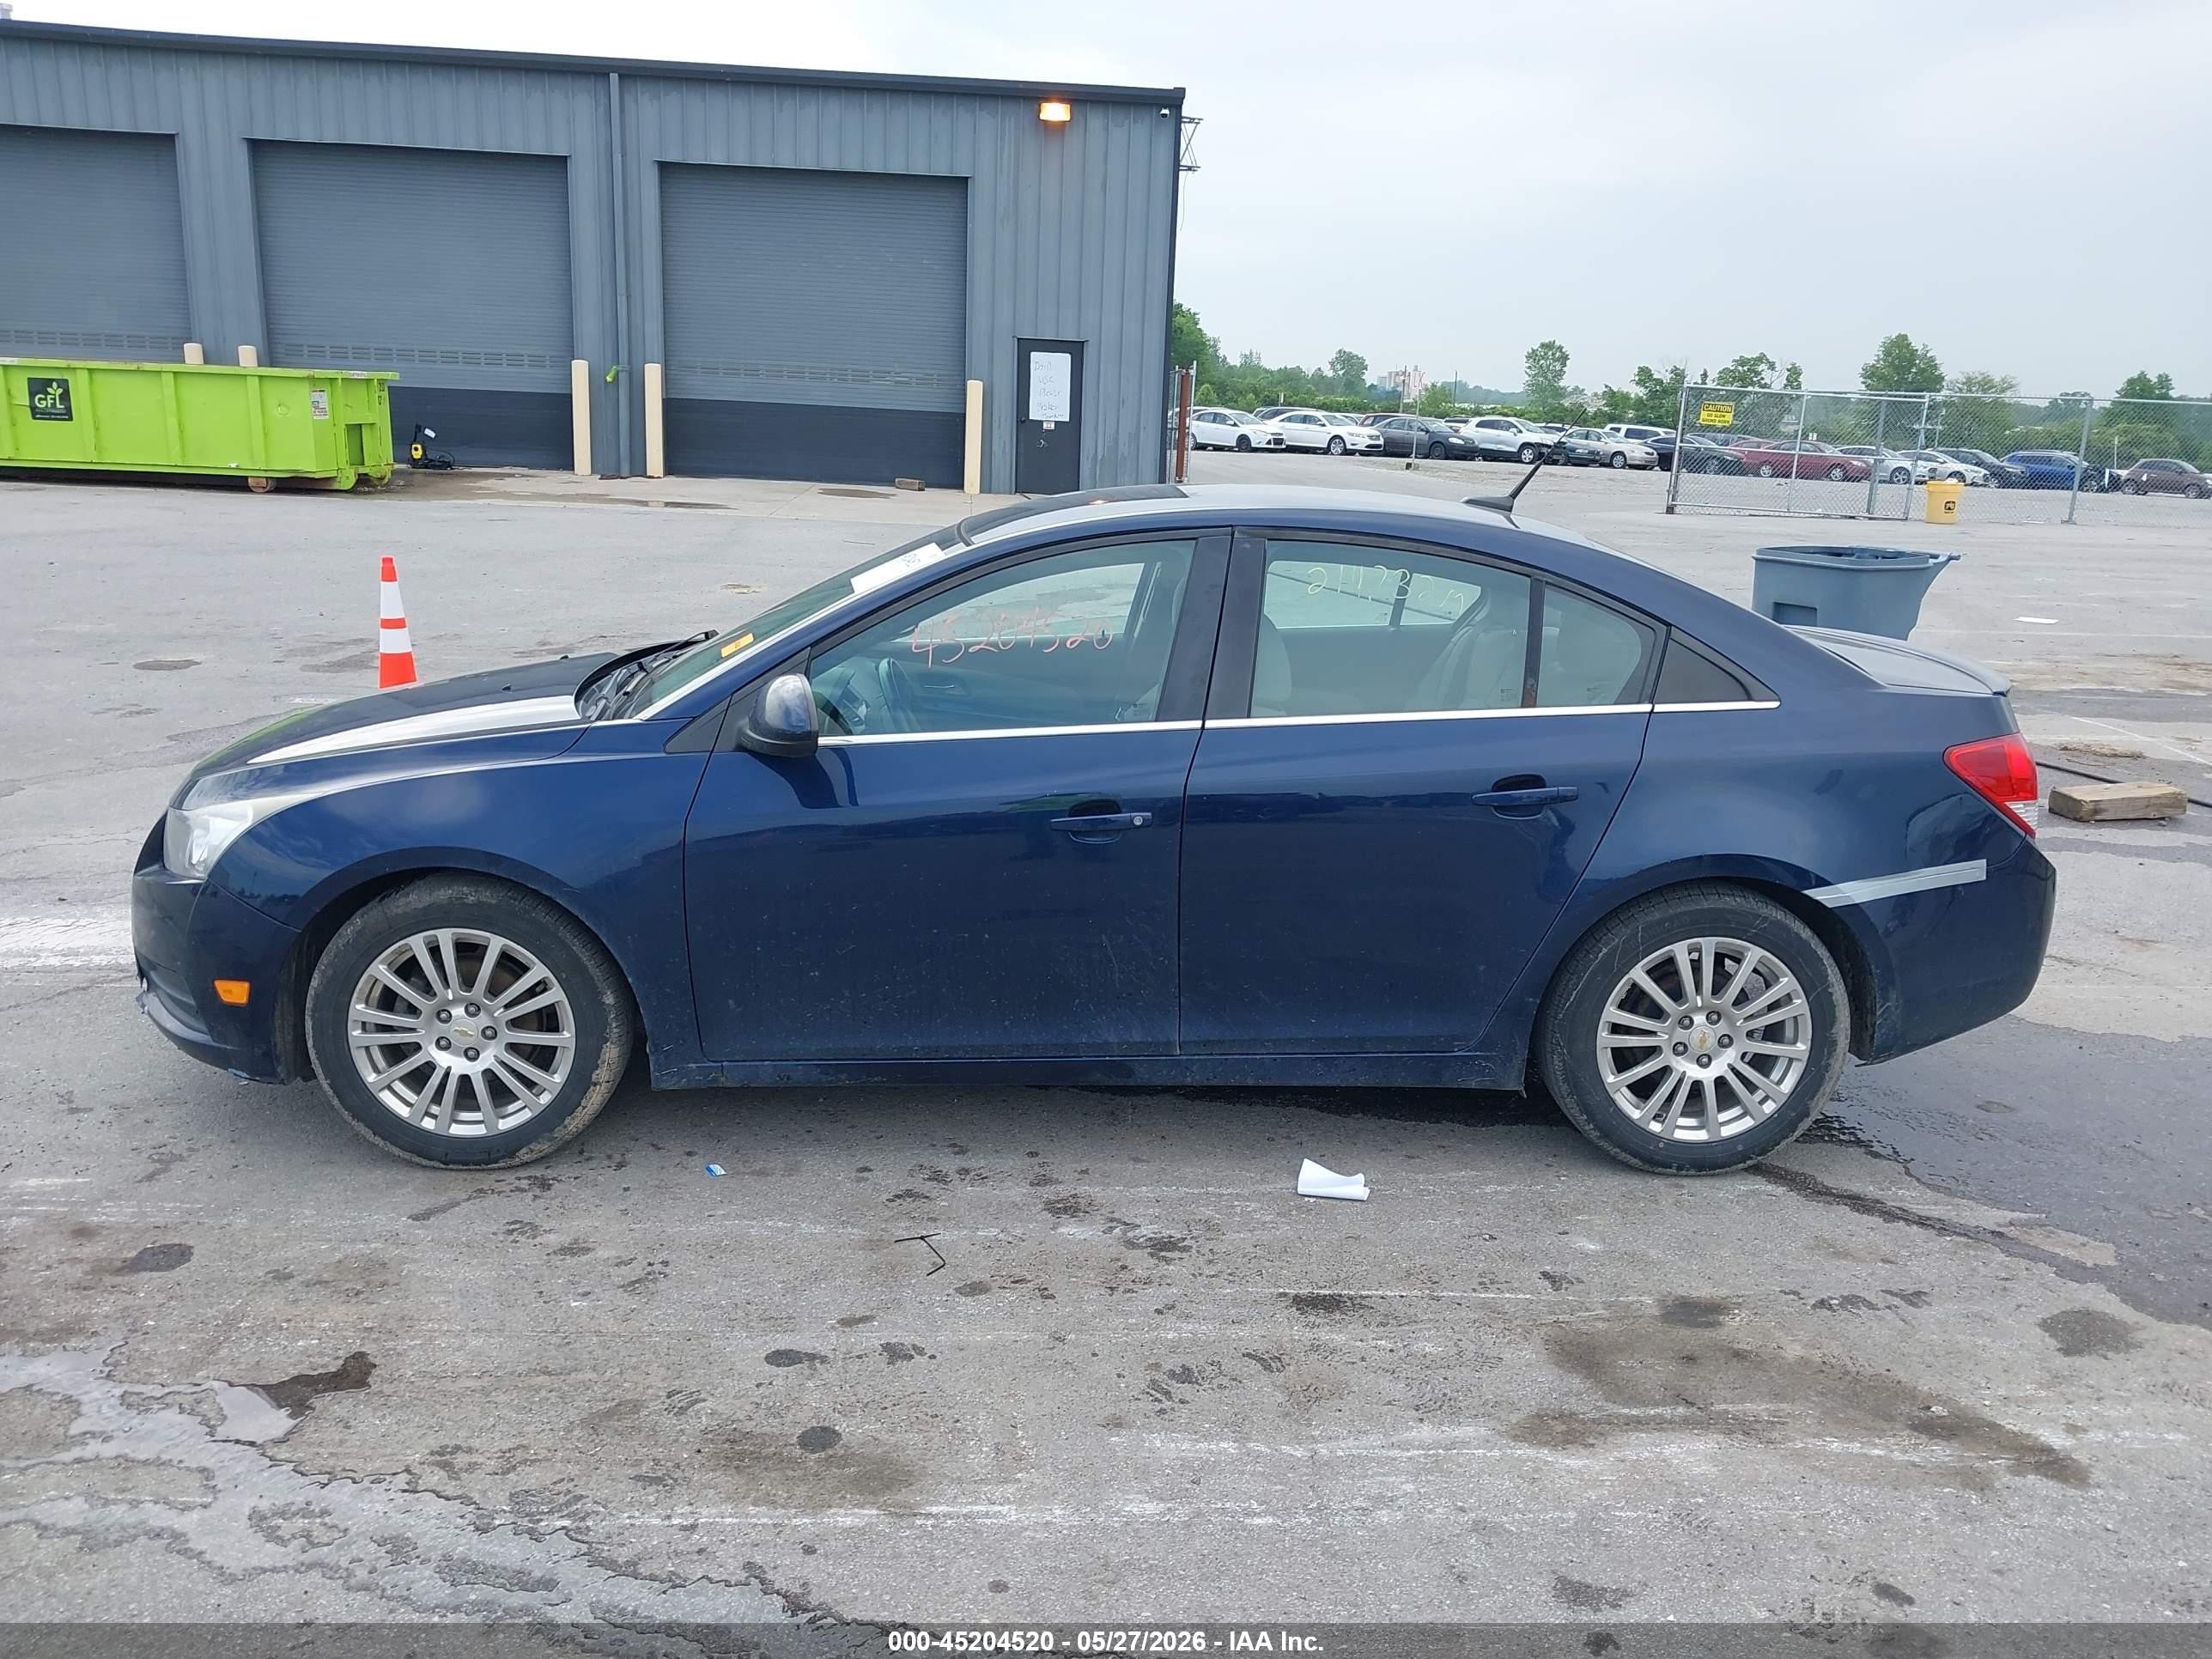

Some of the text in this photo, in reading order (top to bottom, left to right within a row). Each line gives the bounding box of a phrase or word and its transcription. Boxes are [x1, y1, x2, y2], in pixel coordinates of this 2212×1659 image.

[34, 391, 65, 408] GFL
[1704, 404, 1732, 412] CAUTION
[911, 607, 1114, 669] 45204520
